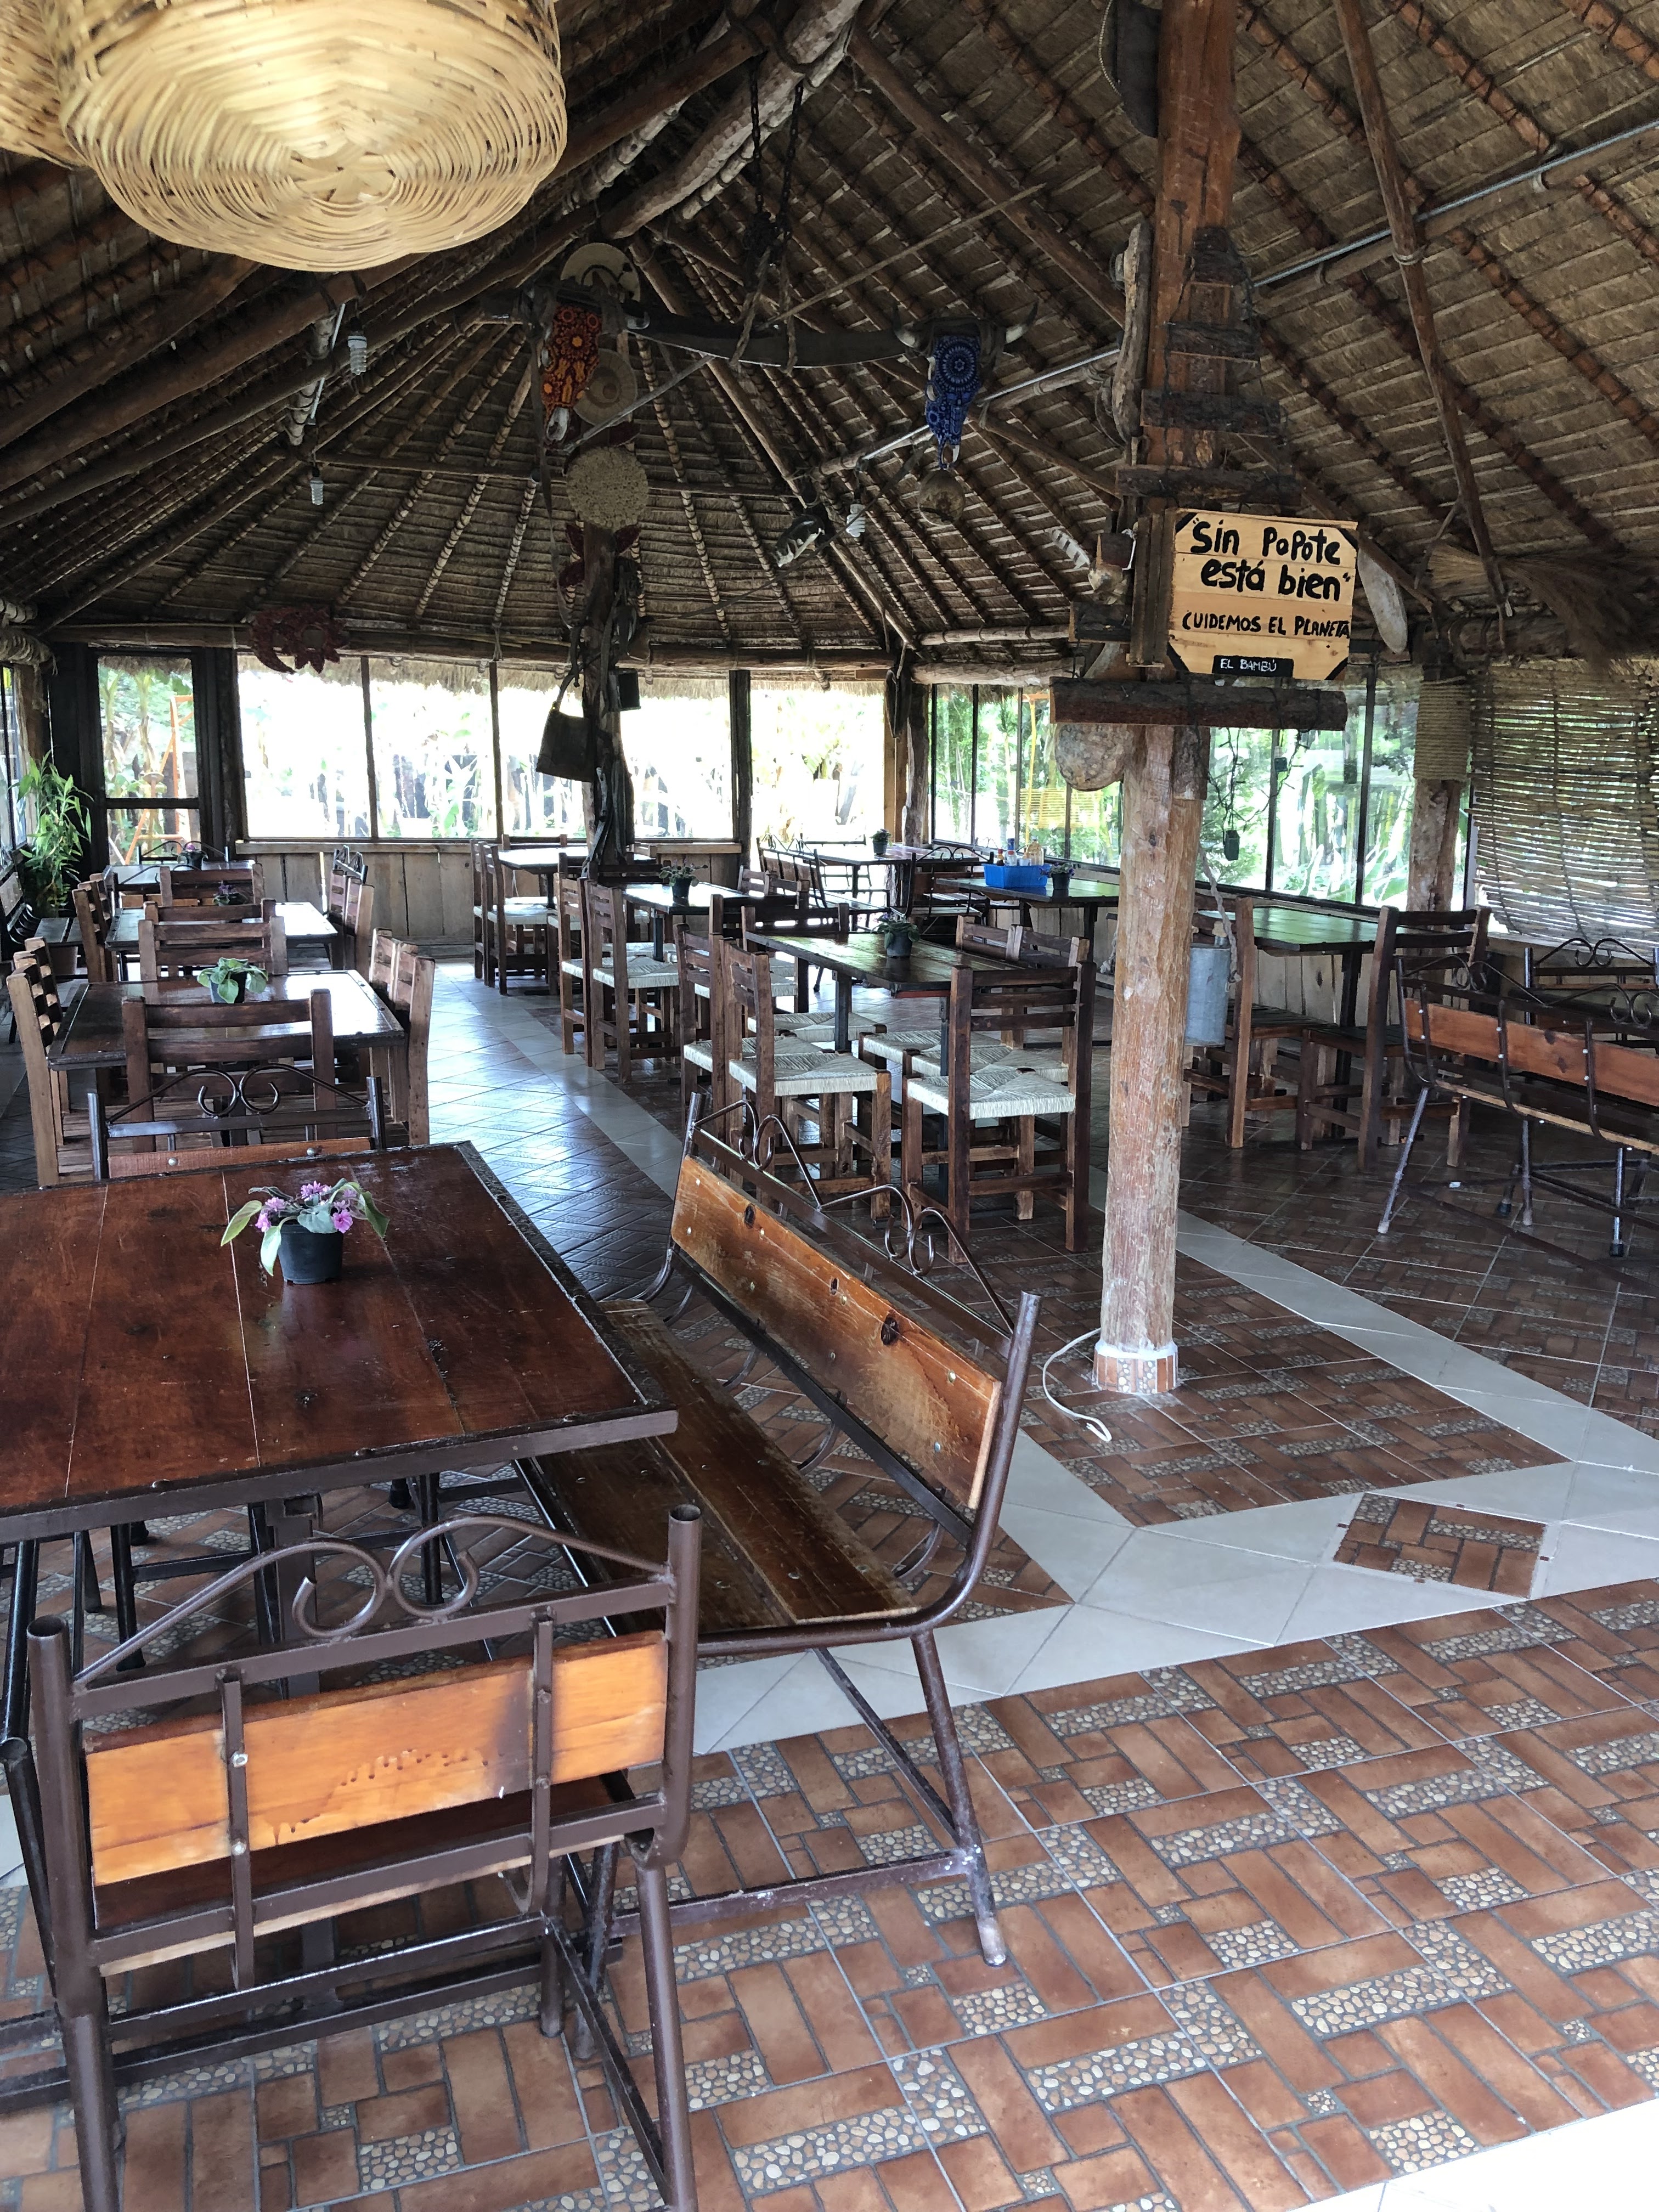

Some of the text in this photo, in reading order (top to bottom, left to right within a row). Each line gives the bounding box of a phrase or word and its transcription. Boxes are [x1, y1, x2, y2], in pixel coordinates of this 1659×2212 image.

[1200, 558, 1266, 592] está
[1182, 612, 1350, 639] CUIDEMOS EL PLANETA
[1220, 658, 1277, 672] EL BAMBÚ
